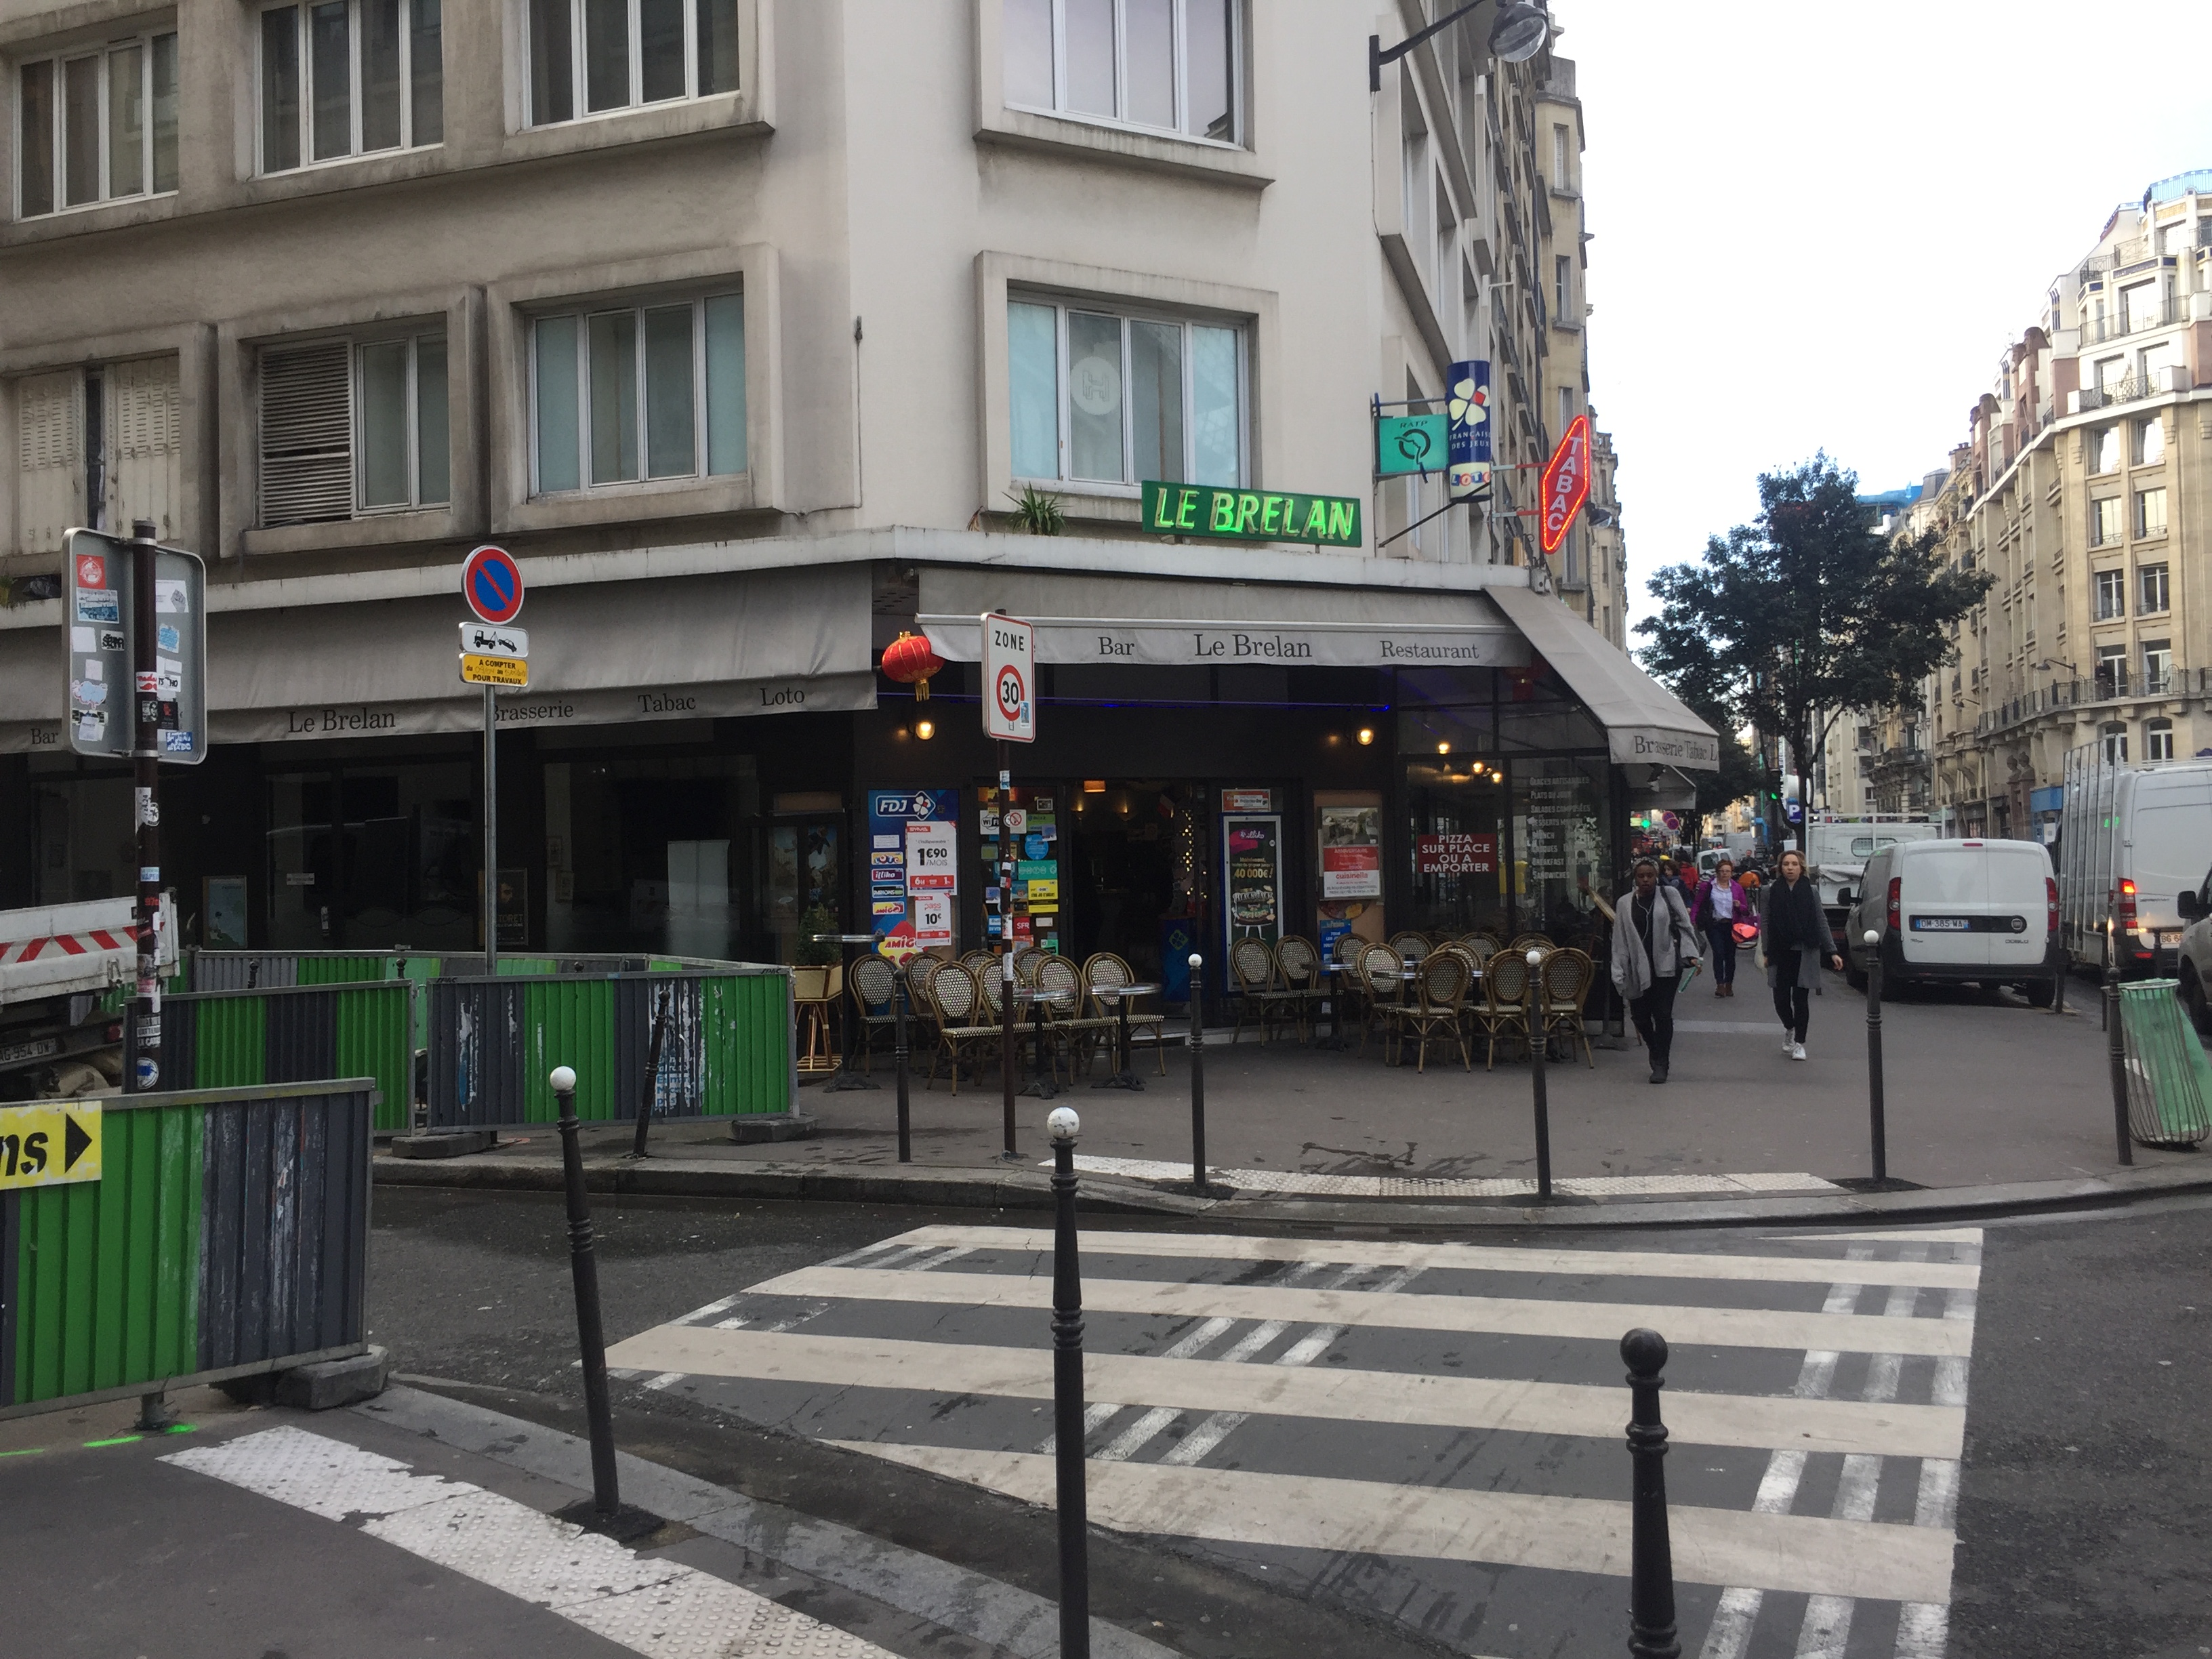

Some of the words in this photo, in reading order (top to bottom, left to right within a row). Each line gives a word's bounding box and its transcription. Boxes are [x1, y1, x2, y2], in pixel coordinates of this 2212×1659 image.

[1399, 420, 1428, 428] RATP
[1547, 436, 1582, 531] TABAC
[1154, 487, 1200, 529] LE
[1209, 491, 1354, 541] BRELAN
[995, 630, 1025, 651] ZONE
[1097, 636, 1134, 656] Bar
[1193, 634, 1225, 657] Le
[1232, 634, 1313, 658] Brelan
[1380, 640, 1480, 659] Restaurant
[485, 660, 516, 669] COMPTER
[492, 676, 522, 684] TRAVAUX
[1002, 680, 1019, 705] 30
[30, 729, 58, 745] Bar
[288, 712, 315, 733] Le
[321, 708, 396, 731] Brelan
[638, 695, 696, 714] Tabac
[760, 687, 805, 706] Loto
[1634, 735, 1683, 757] Brasserie
[1685, 740, 1707, 760] Tabac
[1710, 744, 1717, 761] L
[880, 800, 907, 813] FDJ
[1789, 804, 1800, 817] P
[1529, 818, 1559, 826] ESSERTS
[1438, 834, 1473, 843] PIZZA
[1422, 844, 1445, 853] SUR
[1449, 844, 1490, 853] PLACE
[1439, 854, 1458, 863] OU
[1462, 854, 1472, 863] A
[1235, 868, 1246, 878] 40
[1423, 863, 1490, 873] EMPORTER
[925, 913, 941, 924] 10€
[1921, 920, 1963, 928] DM-385-WA
[884, 936, 924, 949] AMIG
